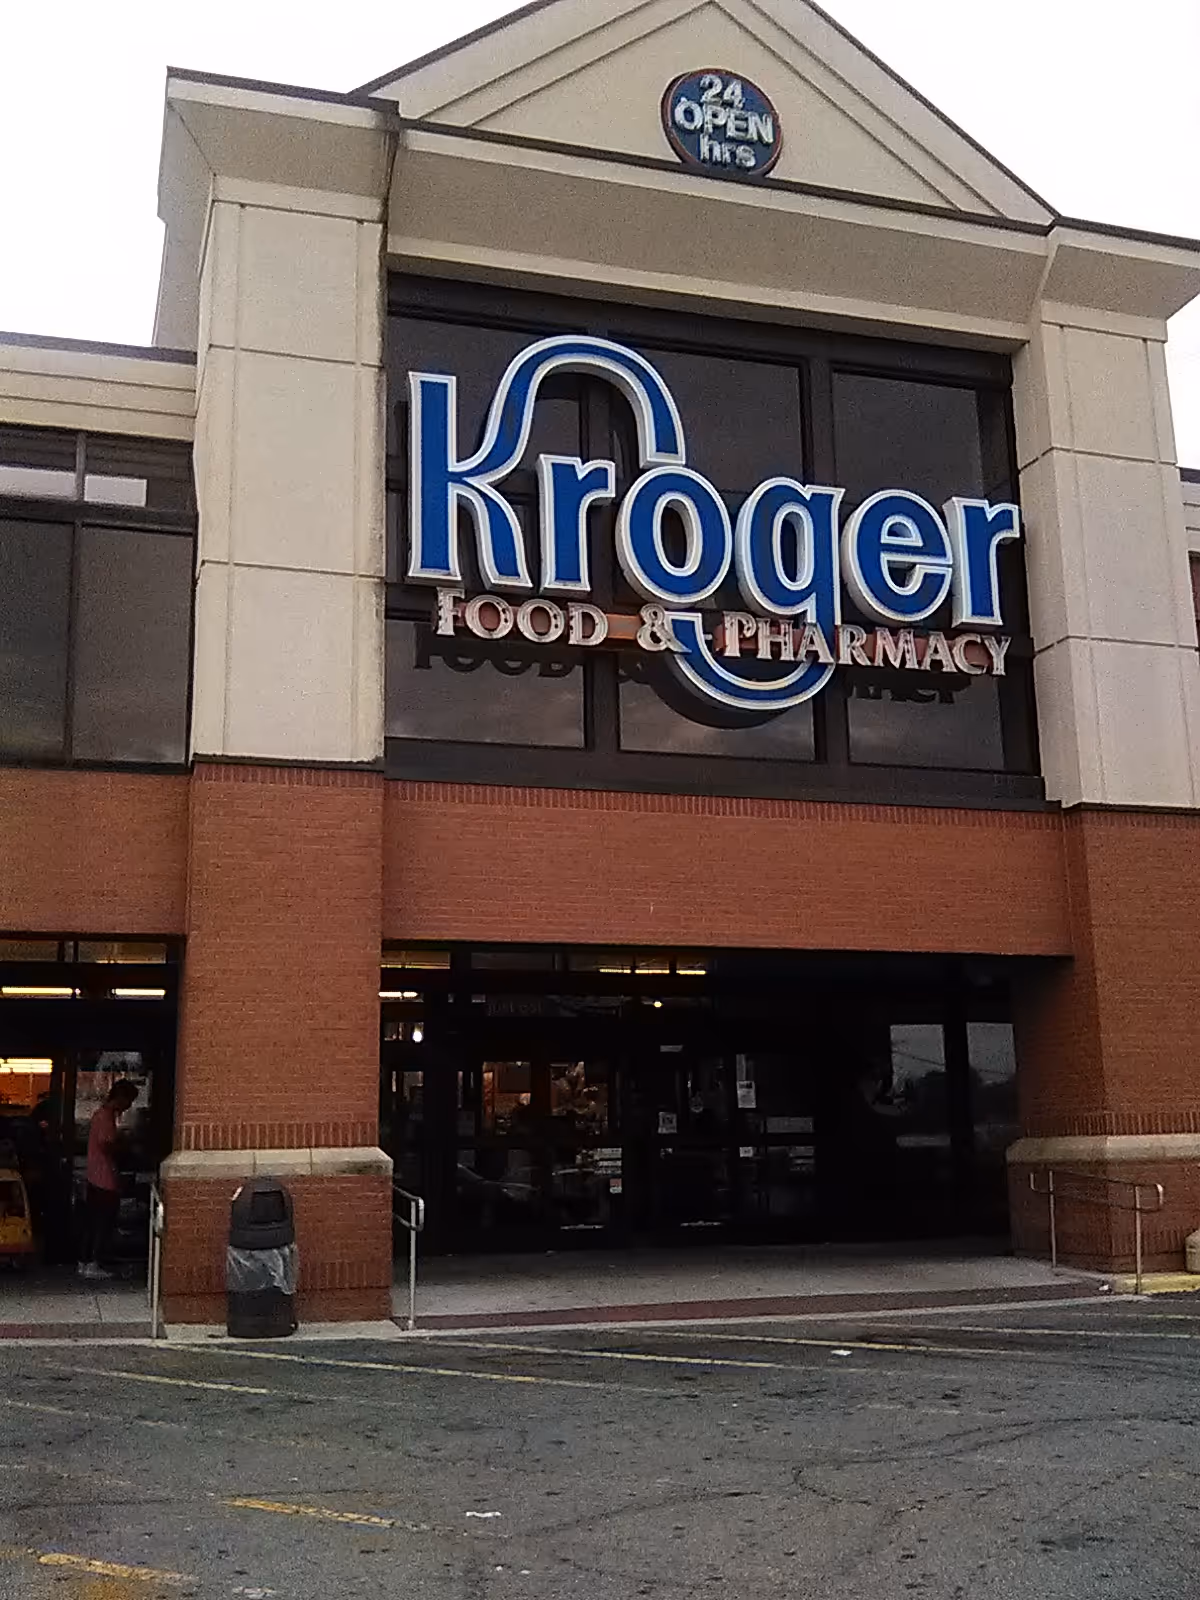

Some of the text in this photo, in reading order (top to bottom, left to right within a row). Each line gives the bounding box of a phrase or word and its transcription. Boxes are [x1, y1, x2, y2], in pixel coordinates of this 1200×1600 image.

[700, 74, 745, 108] 24
[675, 100, 774, 143] OPEN
[700, 134, 756, 167] hrs
[407, 334, 1021, 710] Kroger
[436, 587, 1011, 675] FOOD & PHARMACY
